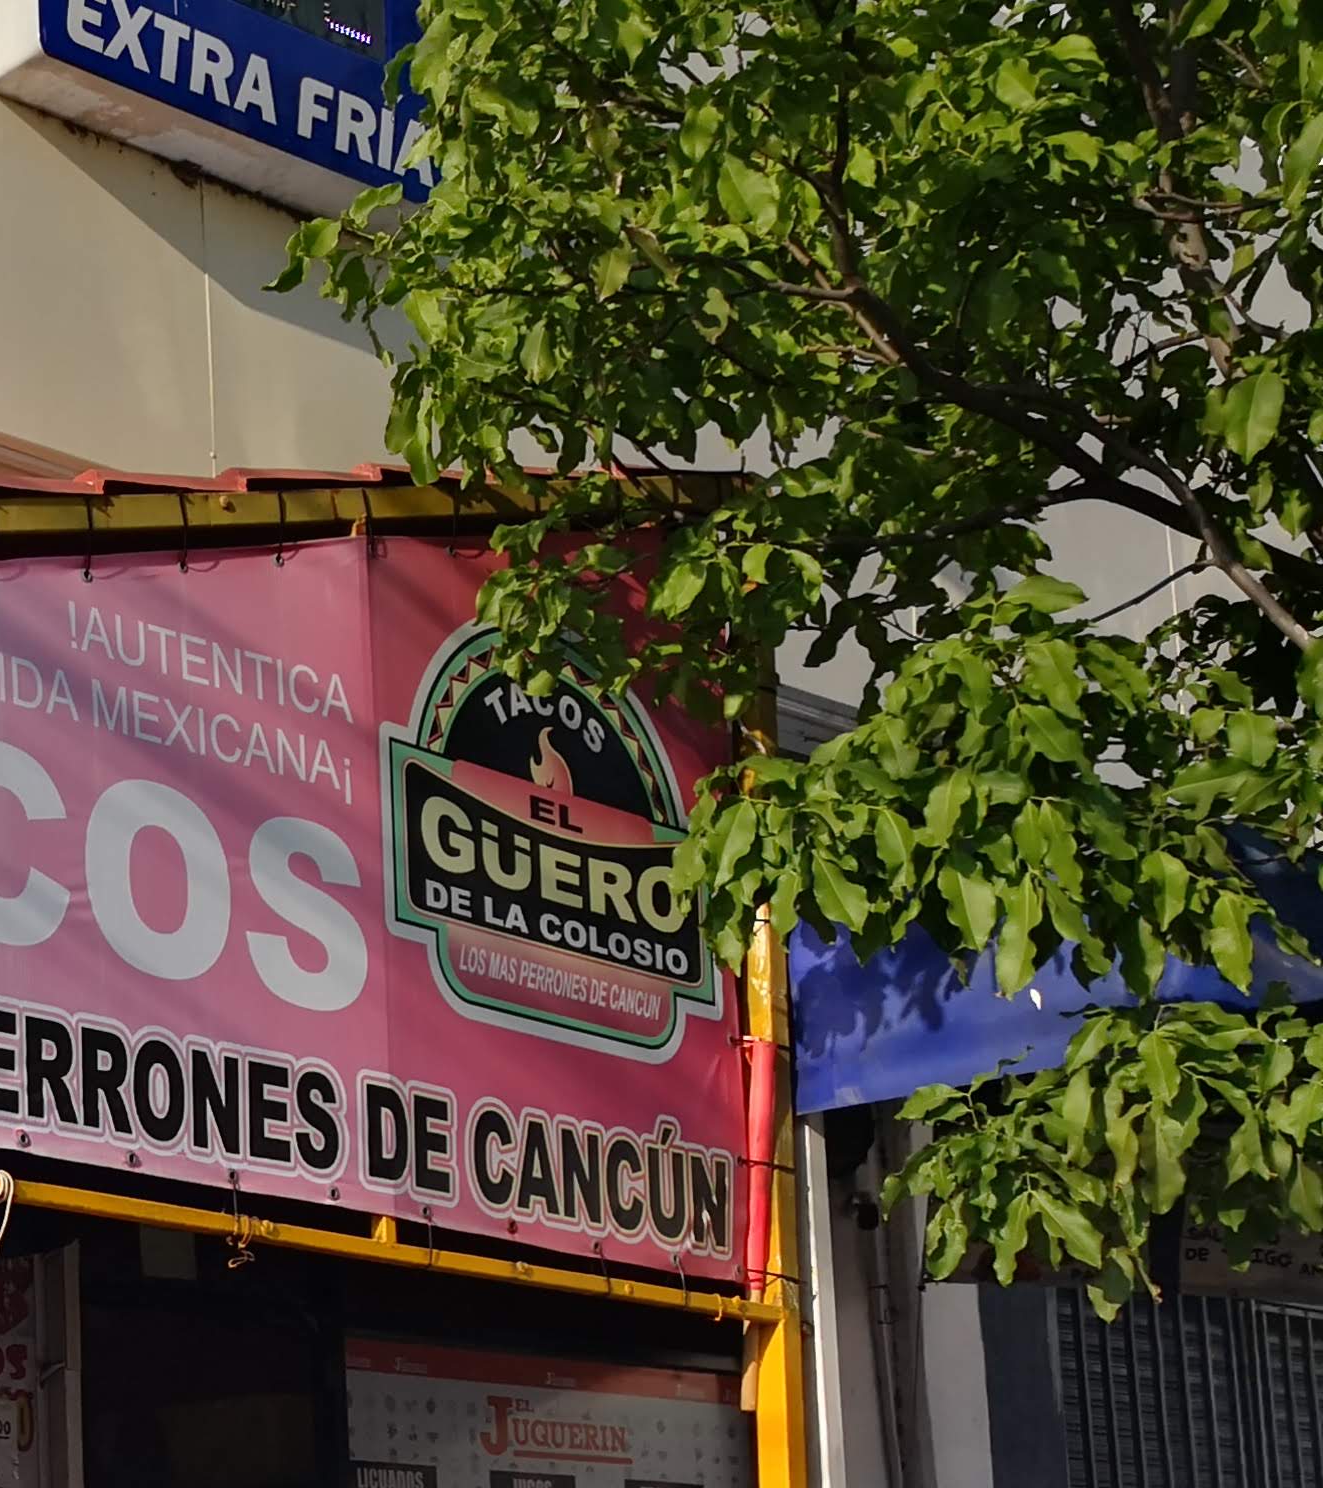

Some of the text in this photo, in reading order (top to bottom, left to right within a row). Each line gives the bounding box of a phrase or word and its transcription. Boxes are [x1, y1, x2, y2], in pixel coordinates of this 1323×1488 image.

[66, 0, 434, 188] EXTRA FRÍA
[484, 682, 605, 753] TACOS
[529, 794, 584, 833] EL
[420, 795, 688, 934] GÜERO
[425, 879, 689, 976] DE LA COLOSIO
[459, 943, 661, 1021] LOS MAS PERRONES DE CANCUN
[366, 1083, 453, 1195] DE
[472, 1110, 729, 1253] CANCÚN
[480, 1395, 628, 1455] JUQUERIN
[515, 1399, 534, 1413] EL
